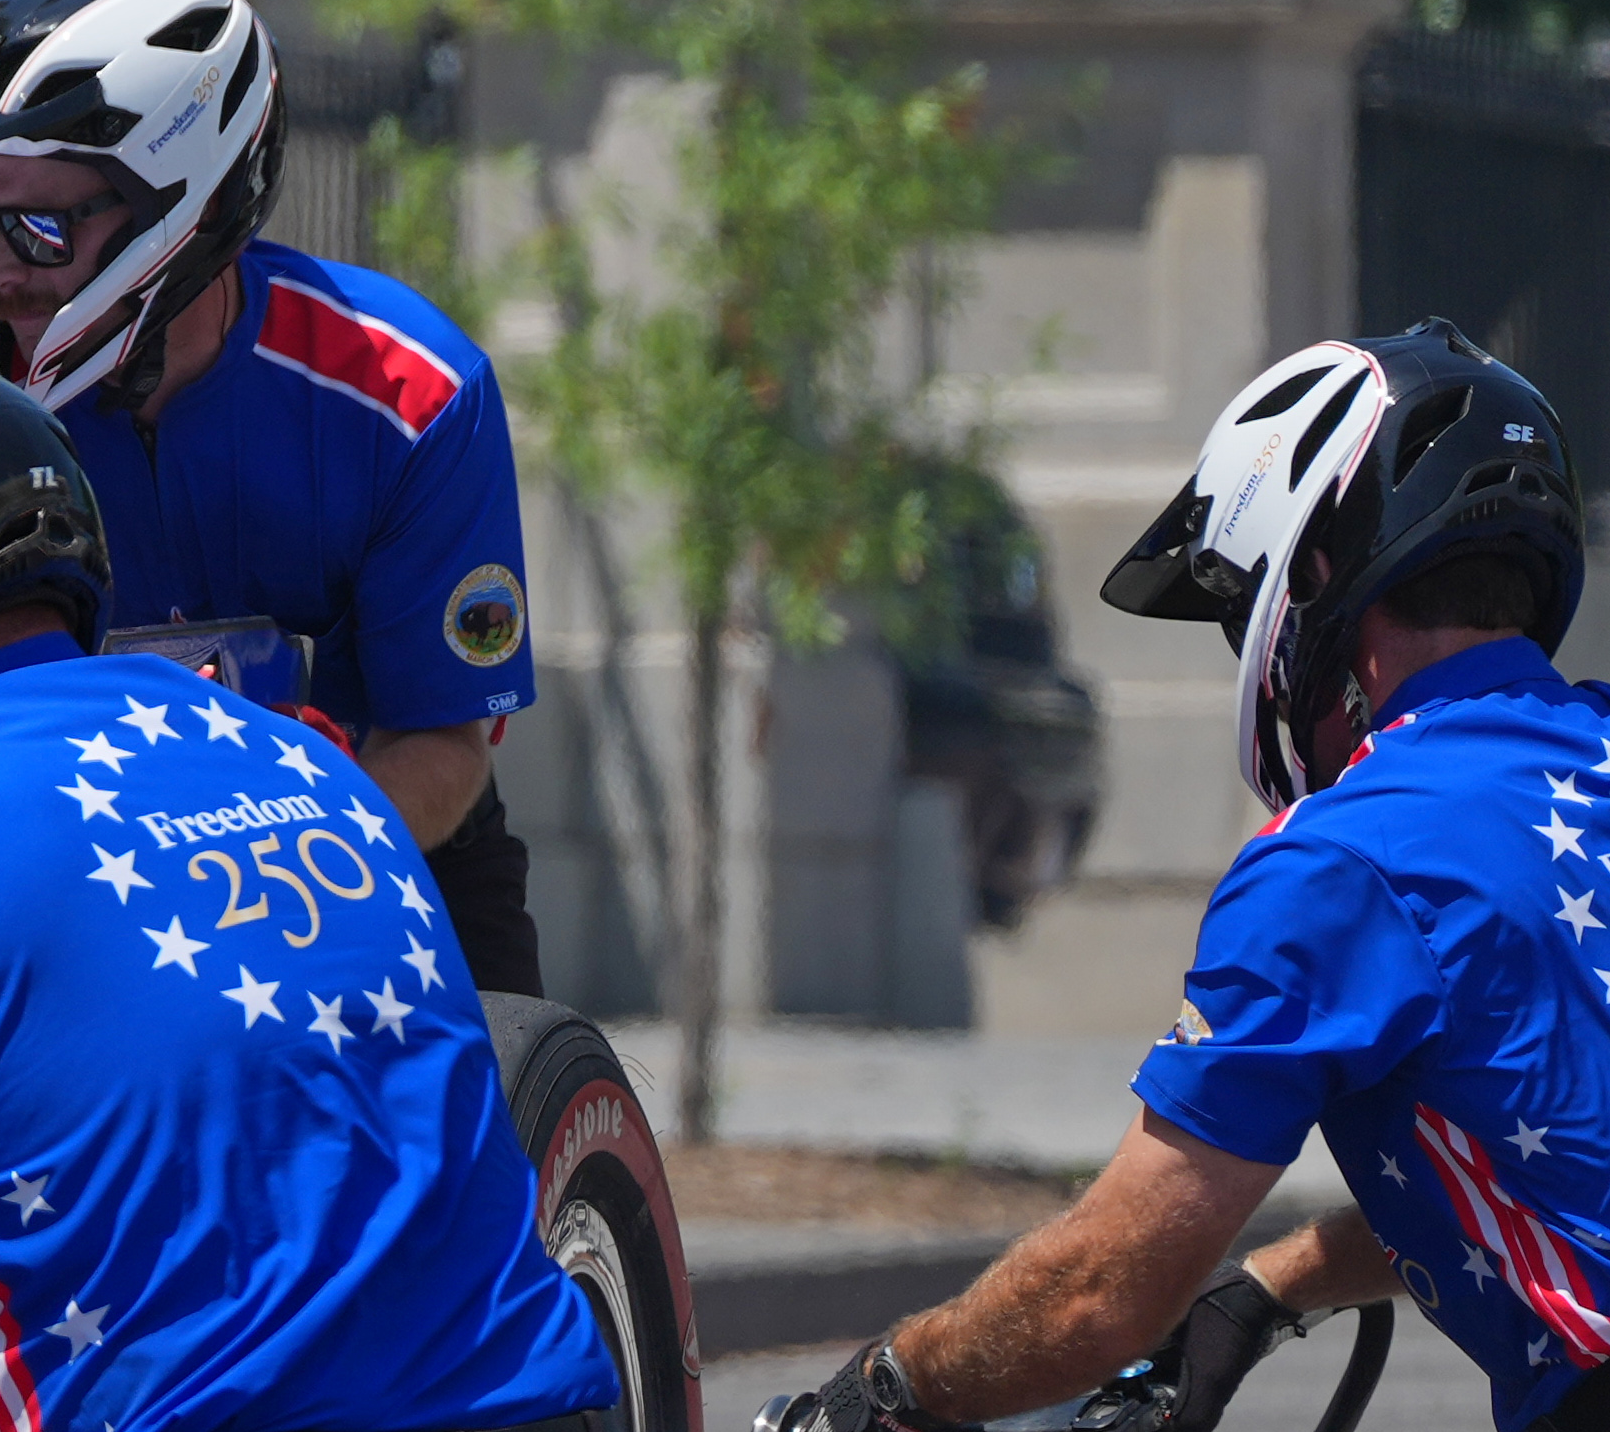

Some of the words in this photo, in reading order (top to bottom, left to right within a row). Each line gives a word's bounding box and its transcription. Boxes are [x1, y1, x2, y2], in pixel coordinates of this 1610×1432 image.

[147, 100, 198, 155] Freedom
[193, 66, 220, 105] 250
[1503, 423, 1535, 443] SE
[29, 466, 59, 489] TL
[1224, 473, 1259, 537] Freedom
[1254, 433, 1281, 474] 250
[488, 695, 519, 711] OMP
[136, 792, 329, 849] Freedom
[187, 831, 375, 948] 250
[538, 1096, 624, 1250] irestone
